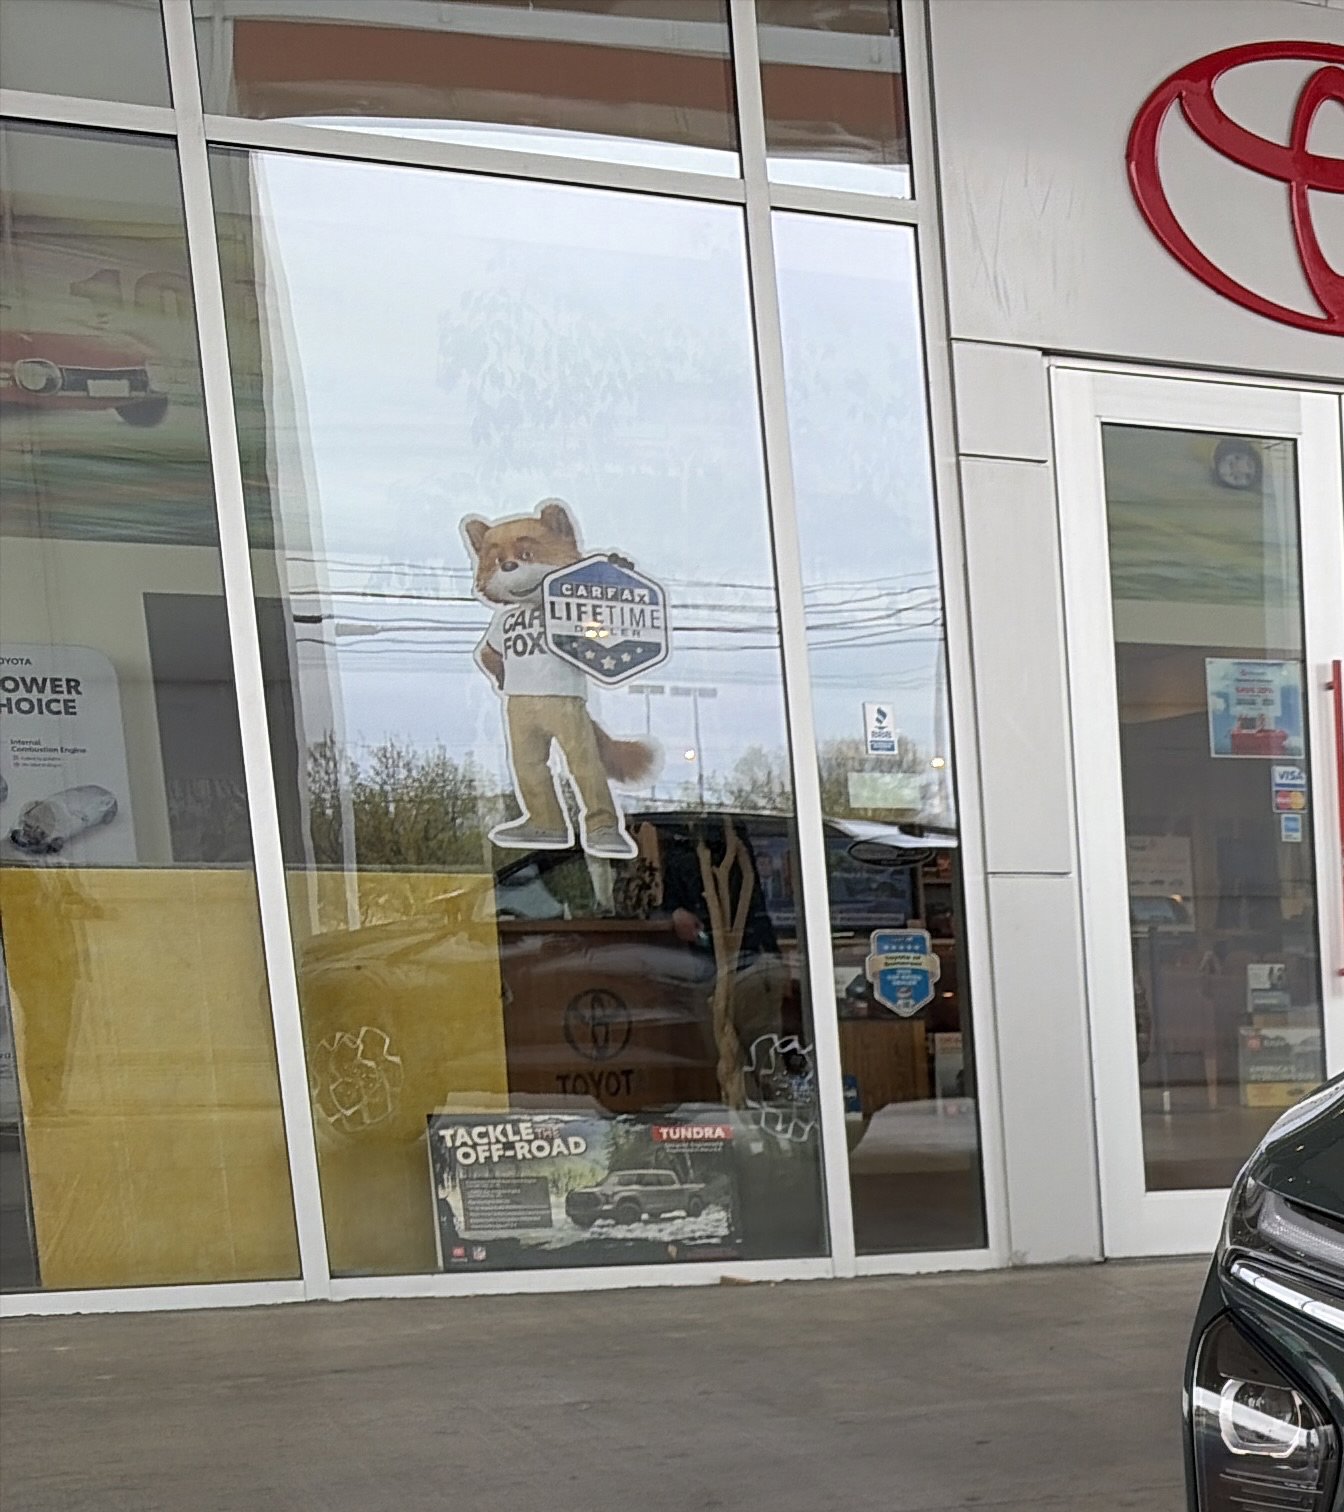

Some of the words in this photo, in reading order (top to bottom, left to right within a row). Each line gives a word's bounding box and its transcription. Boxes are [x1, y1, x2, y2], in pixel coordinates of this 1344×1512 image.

[561, 583, 649, 604] CARFAX
[551, 601, 661, 630] LIFETIME
[503, 631, 547, 660] FOX
[0, 675, 83, 696] OWER
[1278, 770, 1305, 781] VISA
[439, 1122, 535, 1149] TACKLE
[534, 1127, 560, 1139] THE
[659, 1126, 725, 1140] TUNDRA
[456, 1137, 588, 1166] OFF-ROAD
